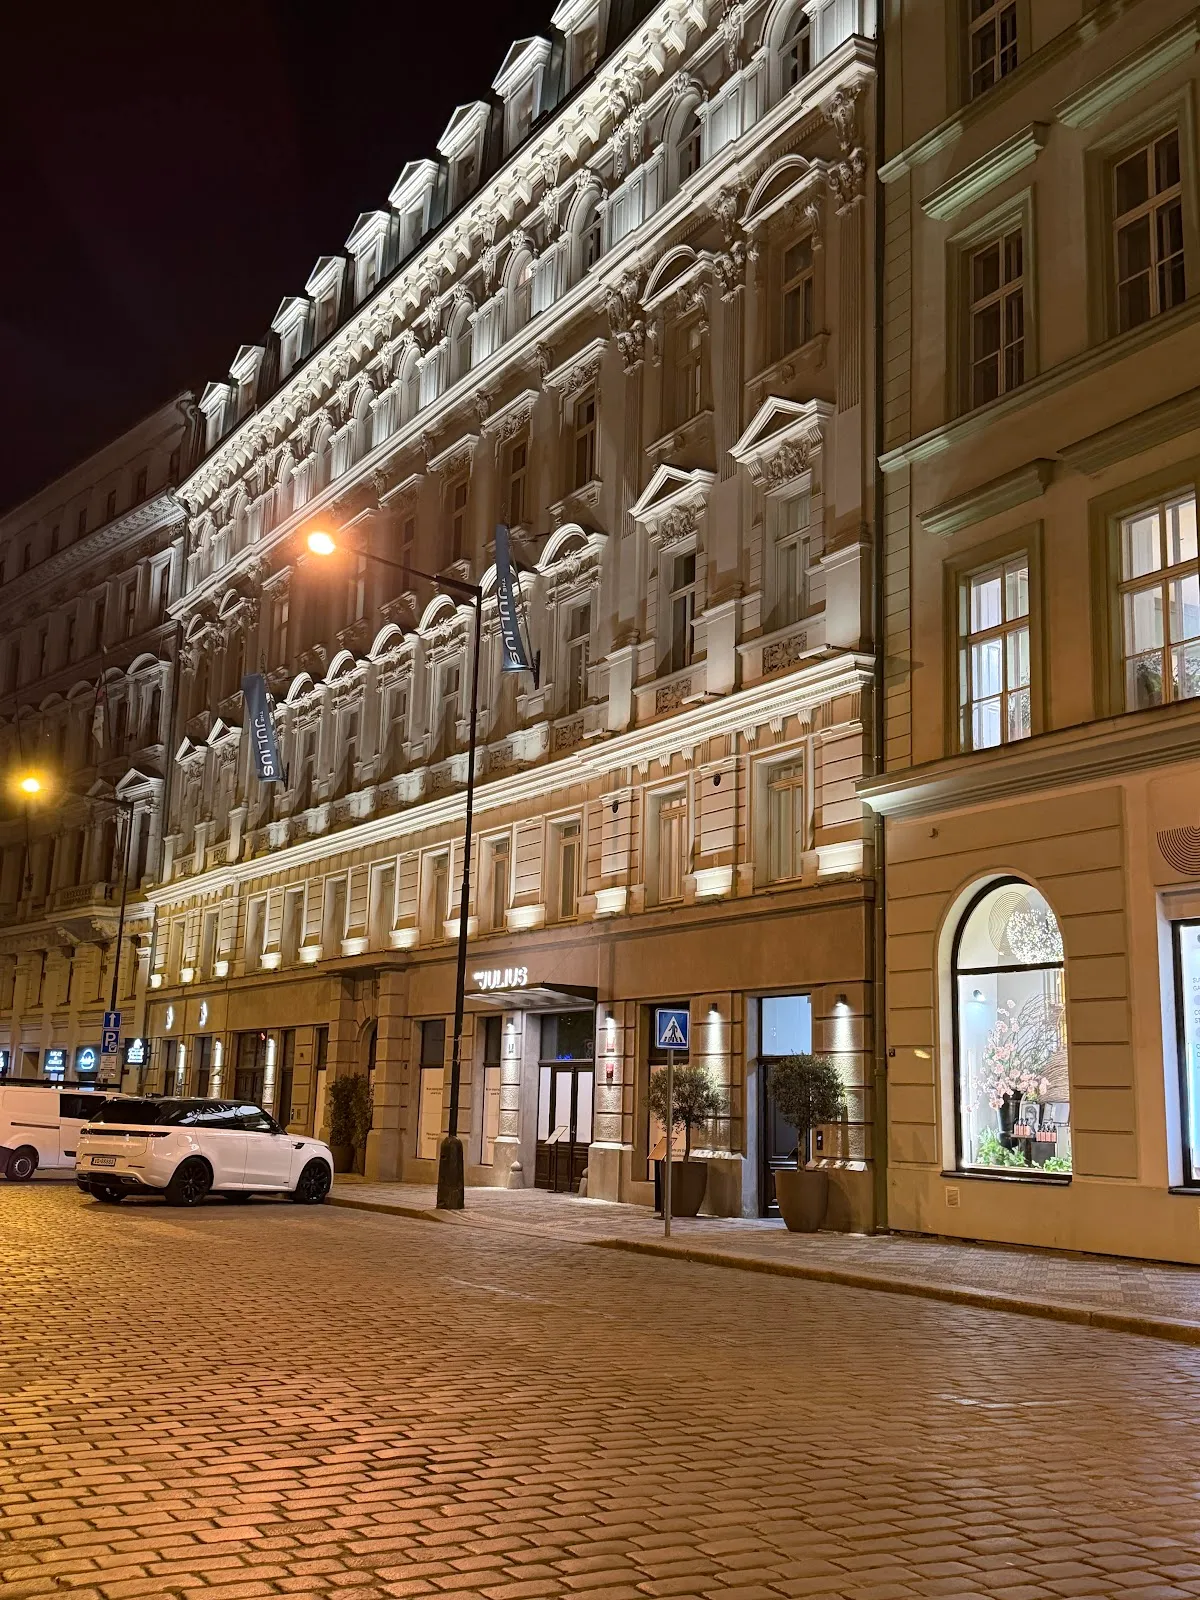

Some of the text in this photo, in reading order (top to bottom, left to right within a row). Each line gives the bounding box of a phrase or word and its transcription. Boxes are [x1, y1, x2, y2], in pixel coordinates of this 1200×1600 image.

[498, 587, 521, 665] JULIUS
[255, 719, 274, 776] JULIUS
[478, 966, 528, 990] JULIUS
[105, 1032, 116, 1047] P
